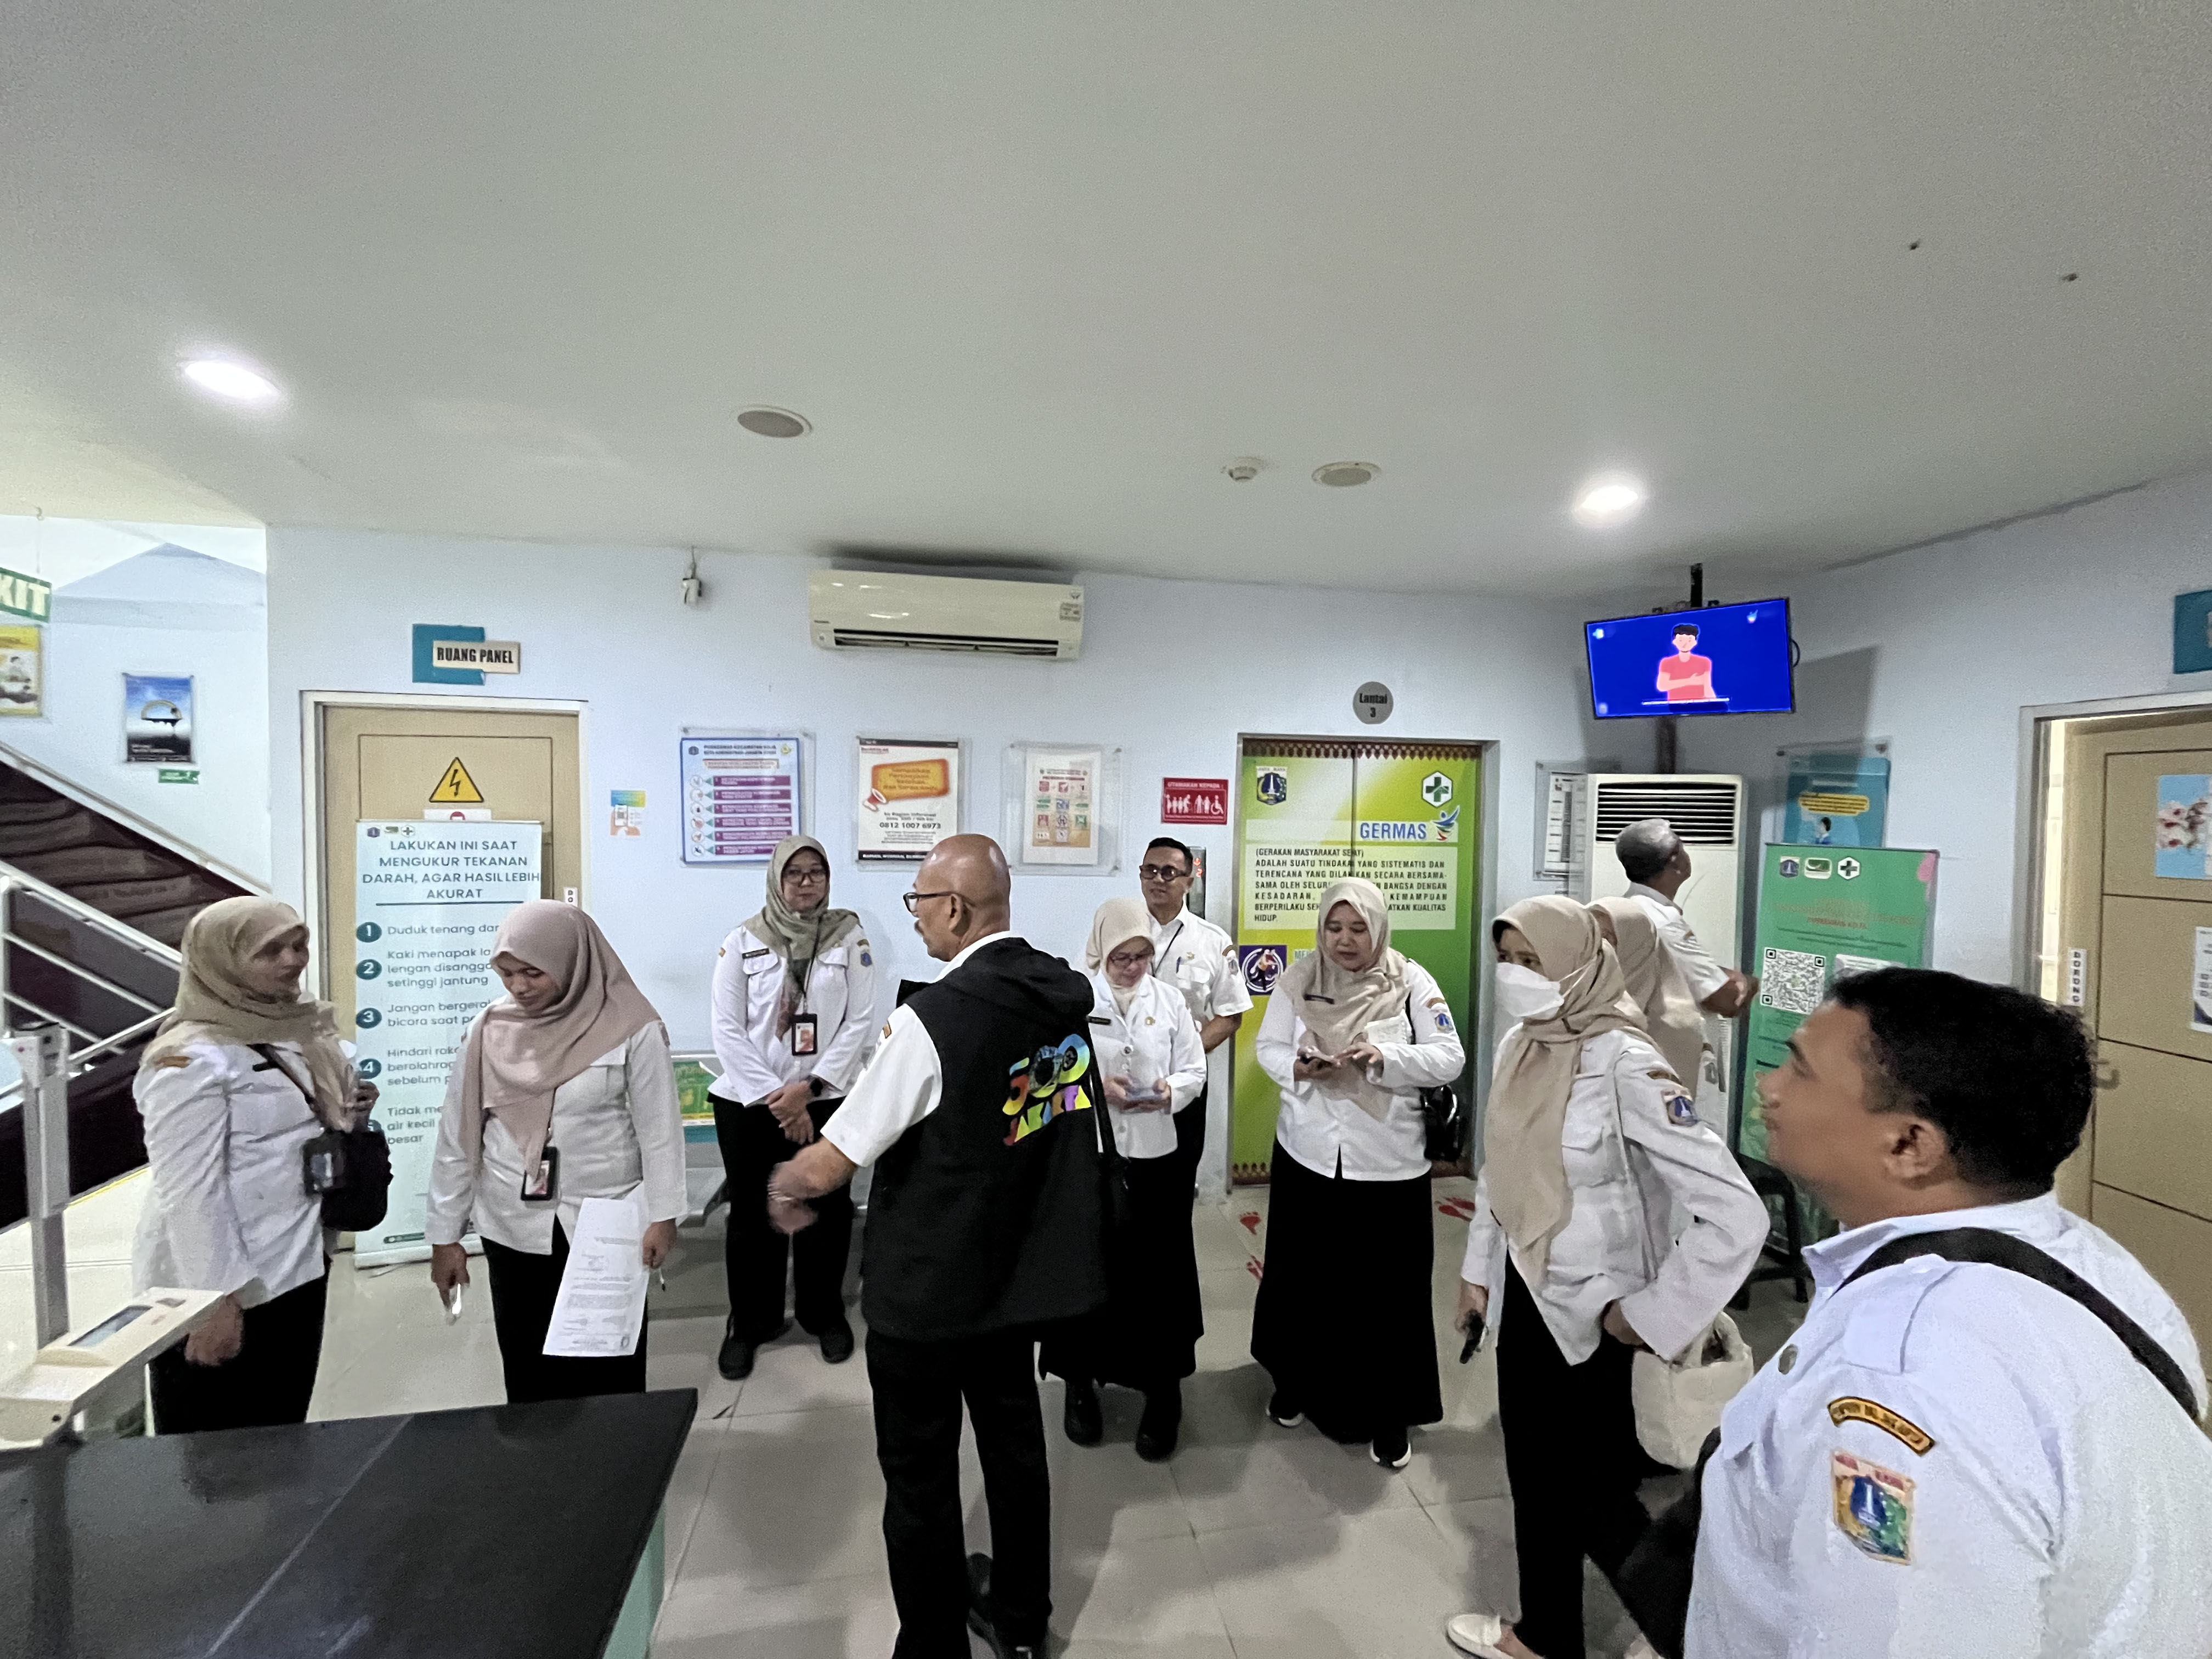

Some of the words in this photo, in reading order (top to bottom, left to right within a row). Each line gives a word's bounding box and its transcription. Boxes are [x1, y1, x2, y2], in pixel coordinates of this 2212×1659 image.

[437, 647, 476, 662] RUANG
[479, 650, 514, 663] PANEL
[1359, 693, 1387, 704] Lantai
[1370, 707, 1376, 718] 3
[1360, 822, 1427, 839] GERMAS
[390, 840, 456, 850] LAKUKAN
[460, 840, 478, 850] INI
[482, 840, 517, 850] SAAT
[1255, 848, 1292, 857] (GERAKAN
[1294, 848, 1340, 856] MASYARAKAT
[1342, 848, 1364, 858] SEAT)
[379, 856, 459, 867] MENGUKUR
[464, 856, 528, 866] TEKANAN
[362, 873, 418, 884] DARAH,
[421, 873, 461, 883] AGAR
[465, 873, 503, 882] HASIL
[505, 872, 540, 882] LEBIH
[426, 889, 483, 899] AKURAT
[366, 924, 372, 937] 1
[387, 925, 428, 935] Duduk
[431, 926, 475, 935] tenang
[387, 950, 414, 960] Kaki
[417, 948, 477, 960] menapak
[363, 962, 375, 974] 2
[387, 964, 431, 975] lengan
[387, 978, 437, 989] setinggi
[439, 976, 489, 987] jantung
[387, 1004, 435, 1014] Jangan
[438, 1000, 491, 1012] bergera
[363, 1010, 374, 1023] 3
[387, 1018, 428, 1027] bicara
[431, 1015, 458, 1025] saat
[387, 1046, 432, 1057] Hindari
[363, 1061, 374, 1073] 4
[387, 1075, 441, 1086] sebelum
[387, 1106, 421, 1116] Tidak
[387, 1121, 403, 1131] air
[407, 1119, 435, 1128] kecil
[387, 1135, 424, 1144] besar
